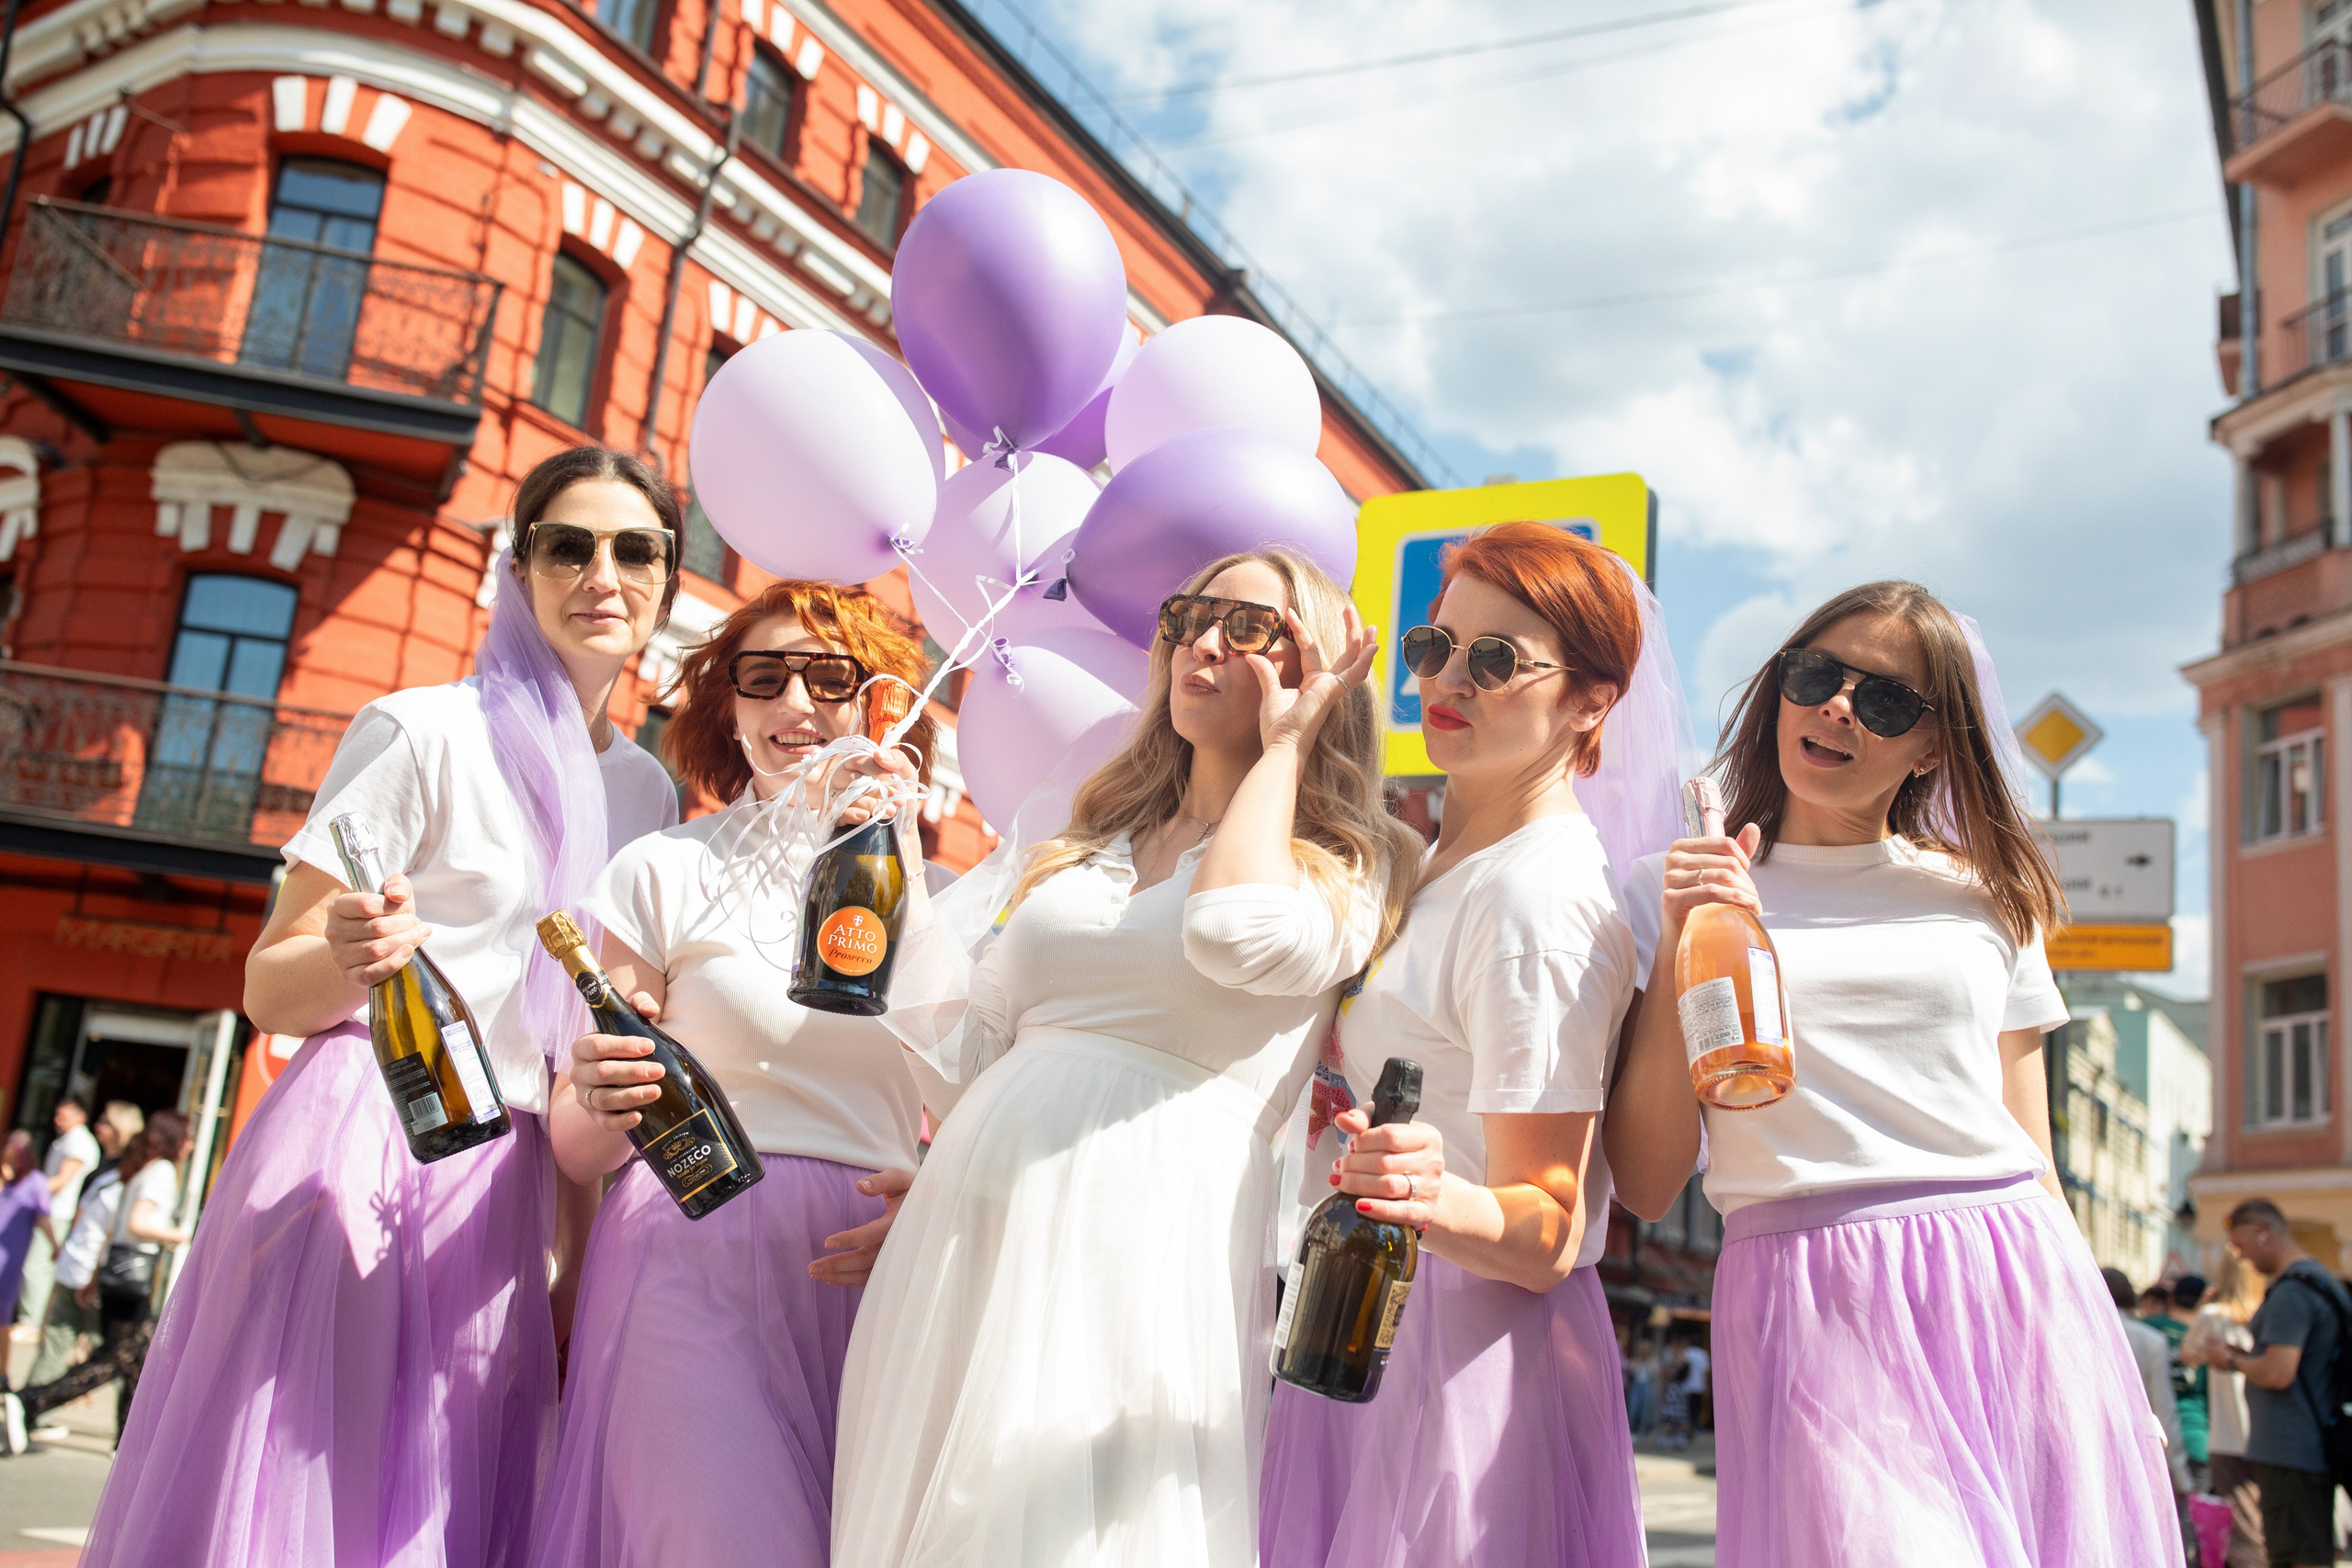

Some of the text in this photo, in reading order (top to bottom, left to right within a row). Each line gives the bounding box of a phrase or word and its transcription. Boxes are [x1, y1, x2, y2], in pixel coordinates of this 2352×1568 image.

[833, 923, 876, 942] ATTO
[828, 934, 877, 954] PRIMO
[828, 947, 873, 964] Prosecco
[673, 1132, 689, 1140] EDITION
[667, 1145, 711, 1178] NOZECO
